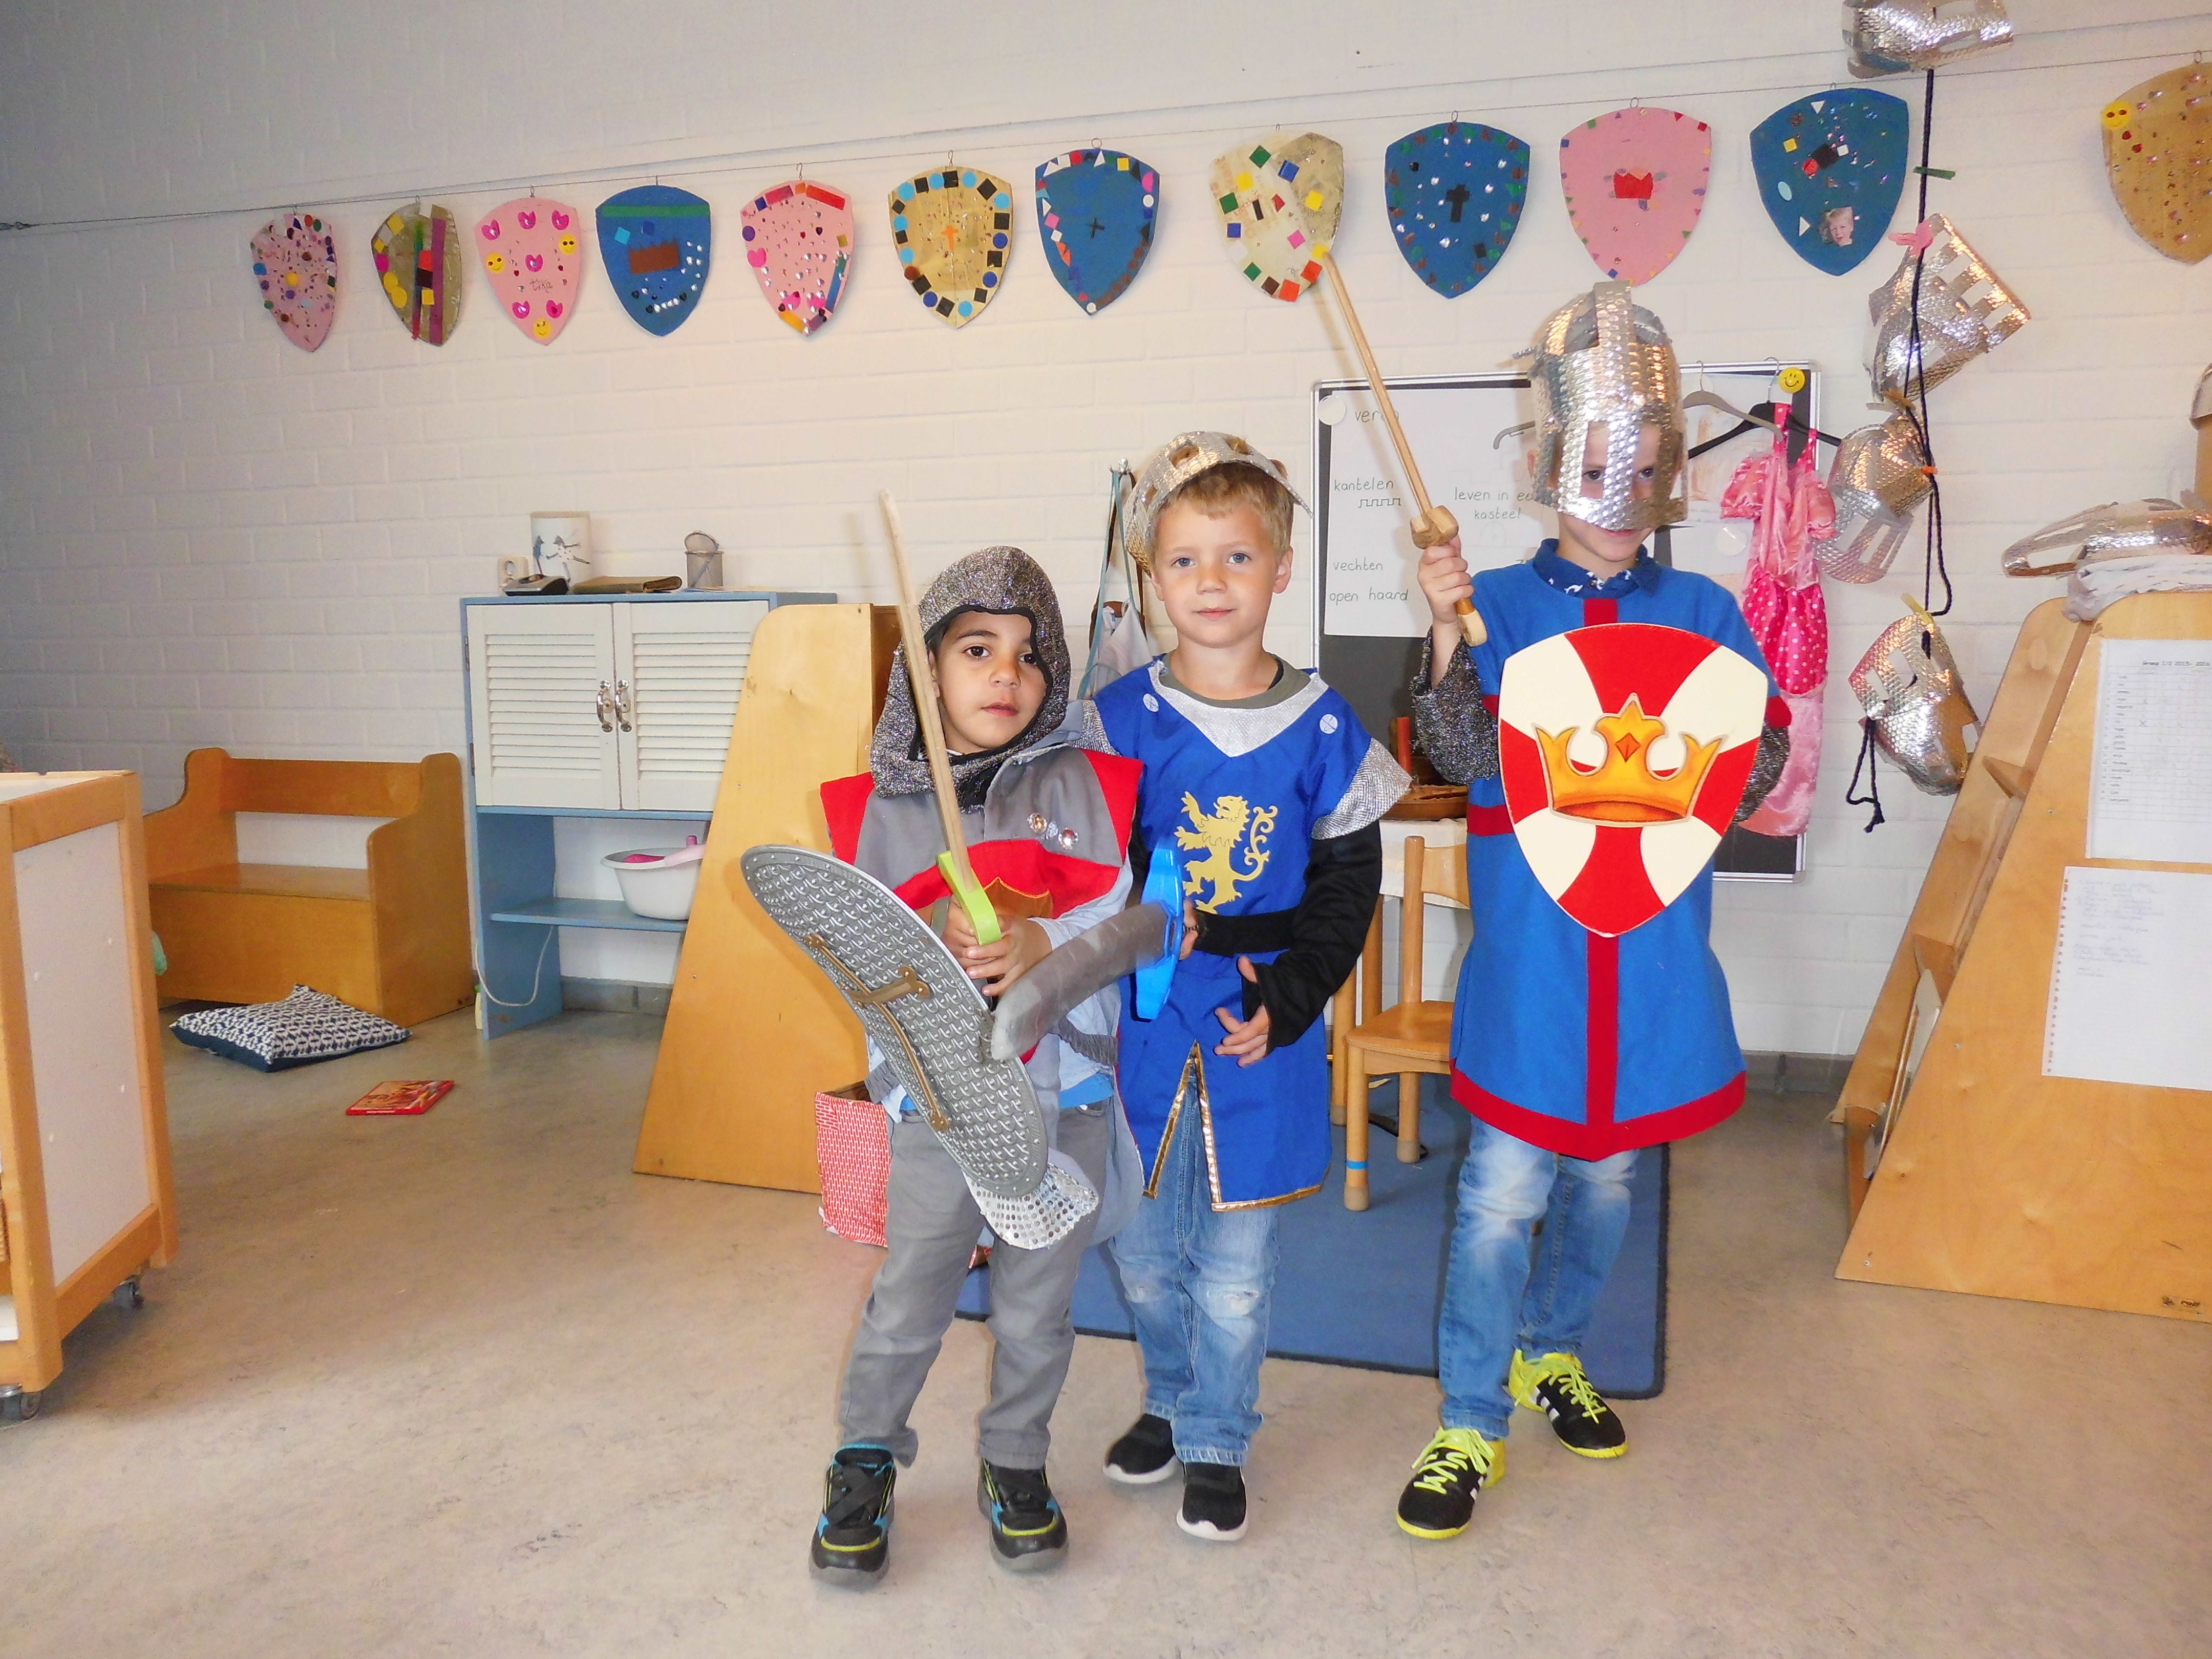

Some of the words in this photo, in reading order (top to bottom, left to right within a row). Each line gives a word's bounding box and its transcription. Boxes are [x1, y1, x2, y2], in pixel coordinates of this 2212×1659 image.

[1334, 477, 1393, 491] kantelen
[1455, 486, 1490, 500] leven
[1517, 492, 1533, 501] ee
[1474, 507, 1521, 519] kasteel
[1333, 557, 1382, 570] vechten
[1329, 592, 1358, 605] open
[1369, 587, 1409, 601] haard
